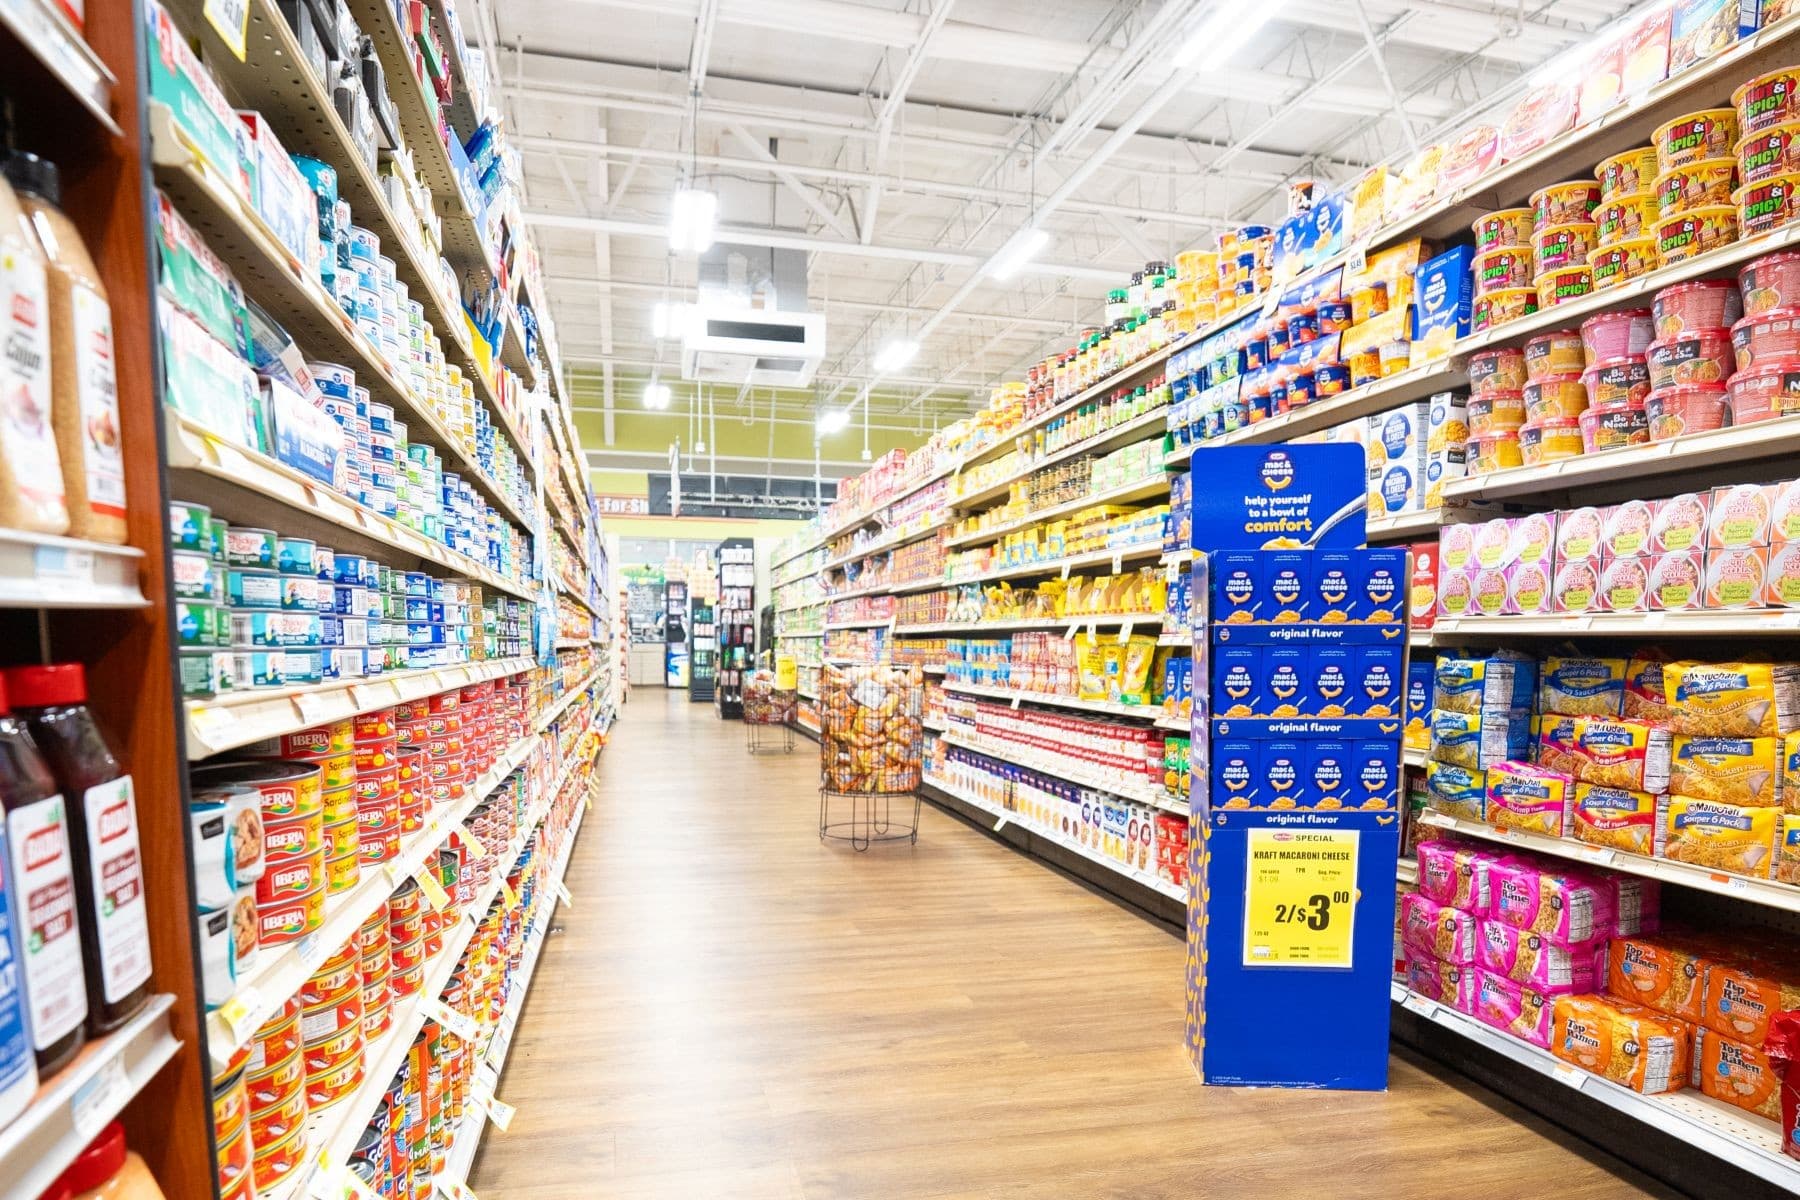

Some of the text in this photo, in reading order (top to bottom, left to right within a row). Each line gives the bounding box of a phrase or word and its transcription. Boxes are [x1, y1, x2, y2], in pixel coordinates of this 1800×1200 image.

[1556, 273, 1590, 286] HOT &
[1556, 284, 1590, 297] SPICY
[1244, 494, 1312, 507] help yourself
[1249, 508, 1260, 518] to
[1270, 507, 1295, 517] bowl
[1297, 507, 1308, 516] of
[1244, 518, 1312, 533] comfort
[1270, 628, 1344, 640] original flavor
[1562, 686, 1573, 696] Soy
[1708, 681, 1736, 691] 6 Pack
[1683, 700, 1741, 714] Roast Chicken
[1269, 722, 1341, 734] original flavor
[292, 734, 328, 746] IBERIA
[1607, 734, 1613, 742] 6
[1688, 745, 1714, 753] Souper
[1716, 744, 1721, 752] 6
[1688, 759, 1708, 775] Roast
[1710, 767, 1743, 776] Chicken
[1519, 786, 1542, 795] 6 Pack
[1506, 802, 1529, 814] Shrimp
[1266, 814, 1339, 826] original flavor
[1594, 820, 1610, 828] Beef
[1683, 816, 1710, 824] Souper
[1719, 818, 1741, 827] Pack
[267, 832, 304, 848] IBERIA
[1254, 851, 1350, 860] KRAFT MACARONI CHEESE
[276, 868, 310, 887] IBERIA
[1502, 880, 1517, 892] Top
[264, 910, 304, 930] IBERIA
[1626, 943, 1642, 957] Top
[1624, 953, 1659, 970] Ramen
[1725, 978, 1746, 995] Top
[1724, 988, 1765, 1012] Ramen
[1567, 1018, 1586, 1033] Top
[1567, 1028, 1599, 1048] Ramen
[1720, 1052, 1761, 1074] Ramen
